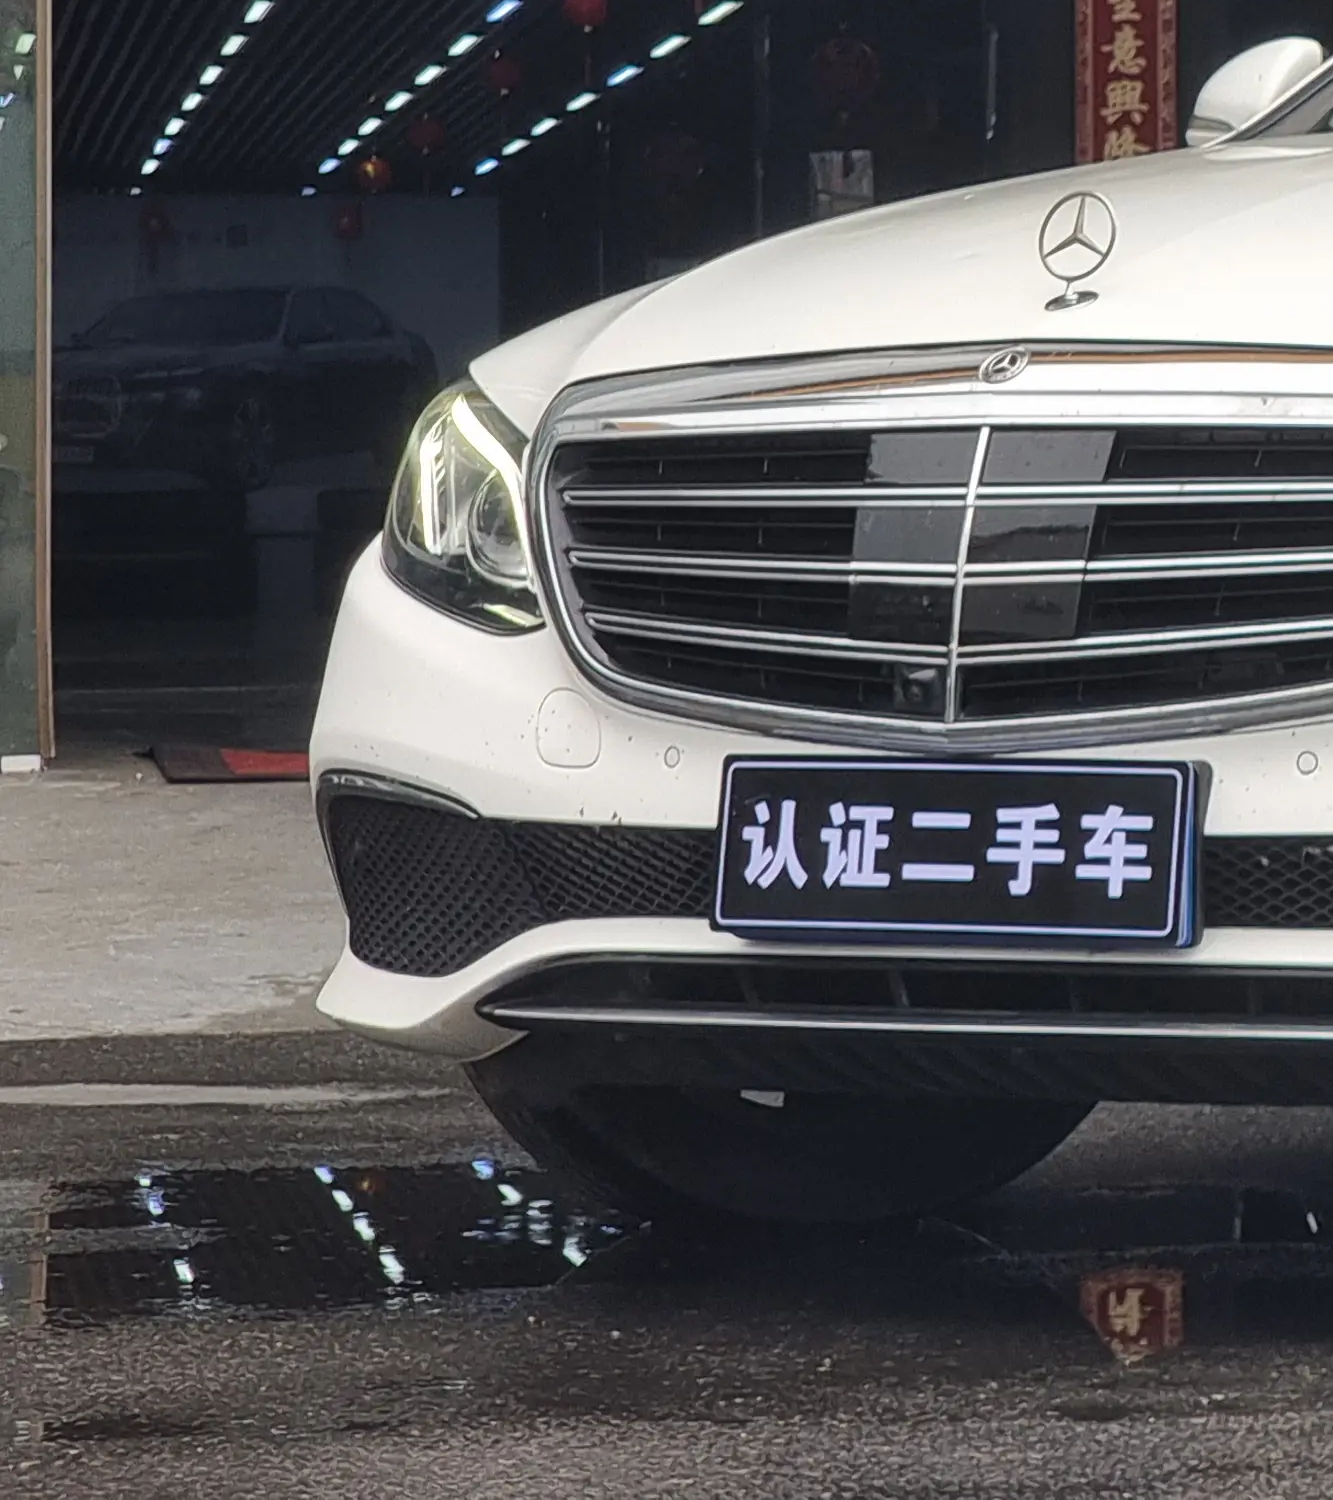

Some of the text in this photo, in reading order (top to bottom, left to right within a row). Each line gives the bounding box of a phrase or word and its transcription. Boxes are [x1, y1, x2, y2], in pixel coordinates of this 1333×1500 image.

[741, 799, 1154, 899] 认证二手车
